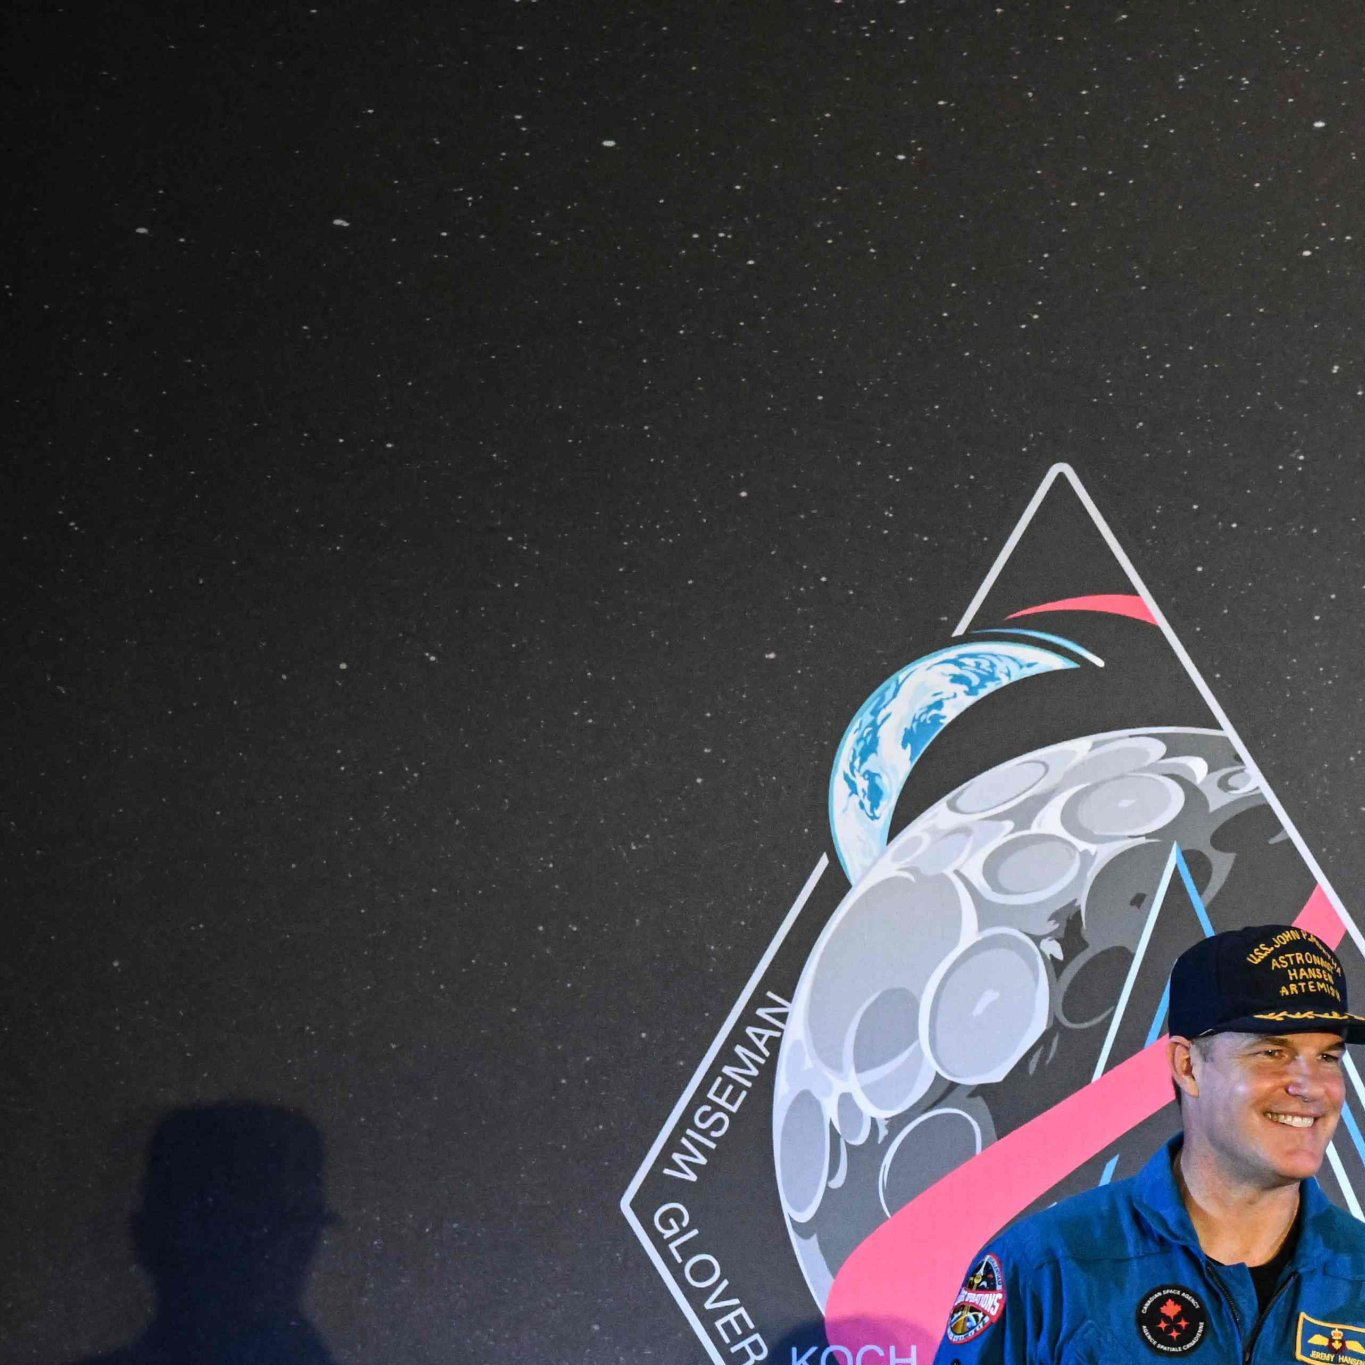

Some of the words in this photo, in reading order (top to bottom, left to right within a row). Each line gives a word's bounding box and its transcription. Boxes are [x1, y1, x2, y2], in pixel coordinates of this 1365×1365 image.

[1272, 929, 1300, 948] JOHN
[1288, 967, 1335, 985] HANSEN
[662, 991, 793, 1183] WISEMAN
[1142, 1292, 1162, 1314] CANADIAN
[1181, 1292, 1200, 1309] AGENCY
[1142, 1325, 1157, 1345] AGENCE
[1157, 1343, 1182, 1352] SPATIALE
[1310, 1350, 1335, 1362] JEREMY
